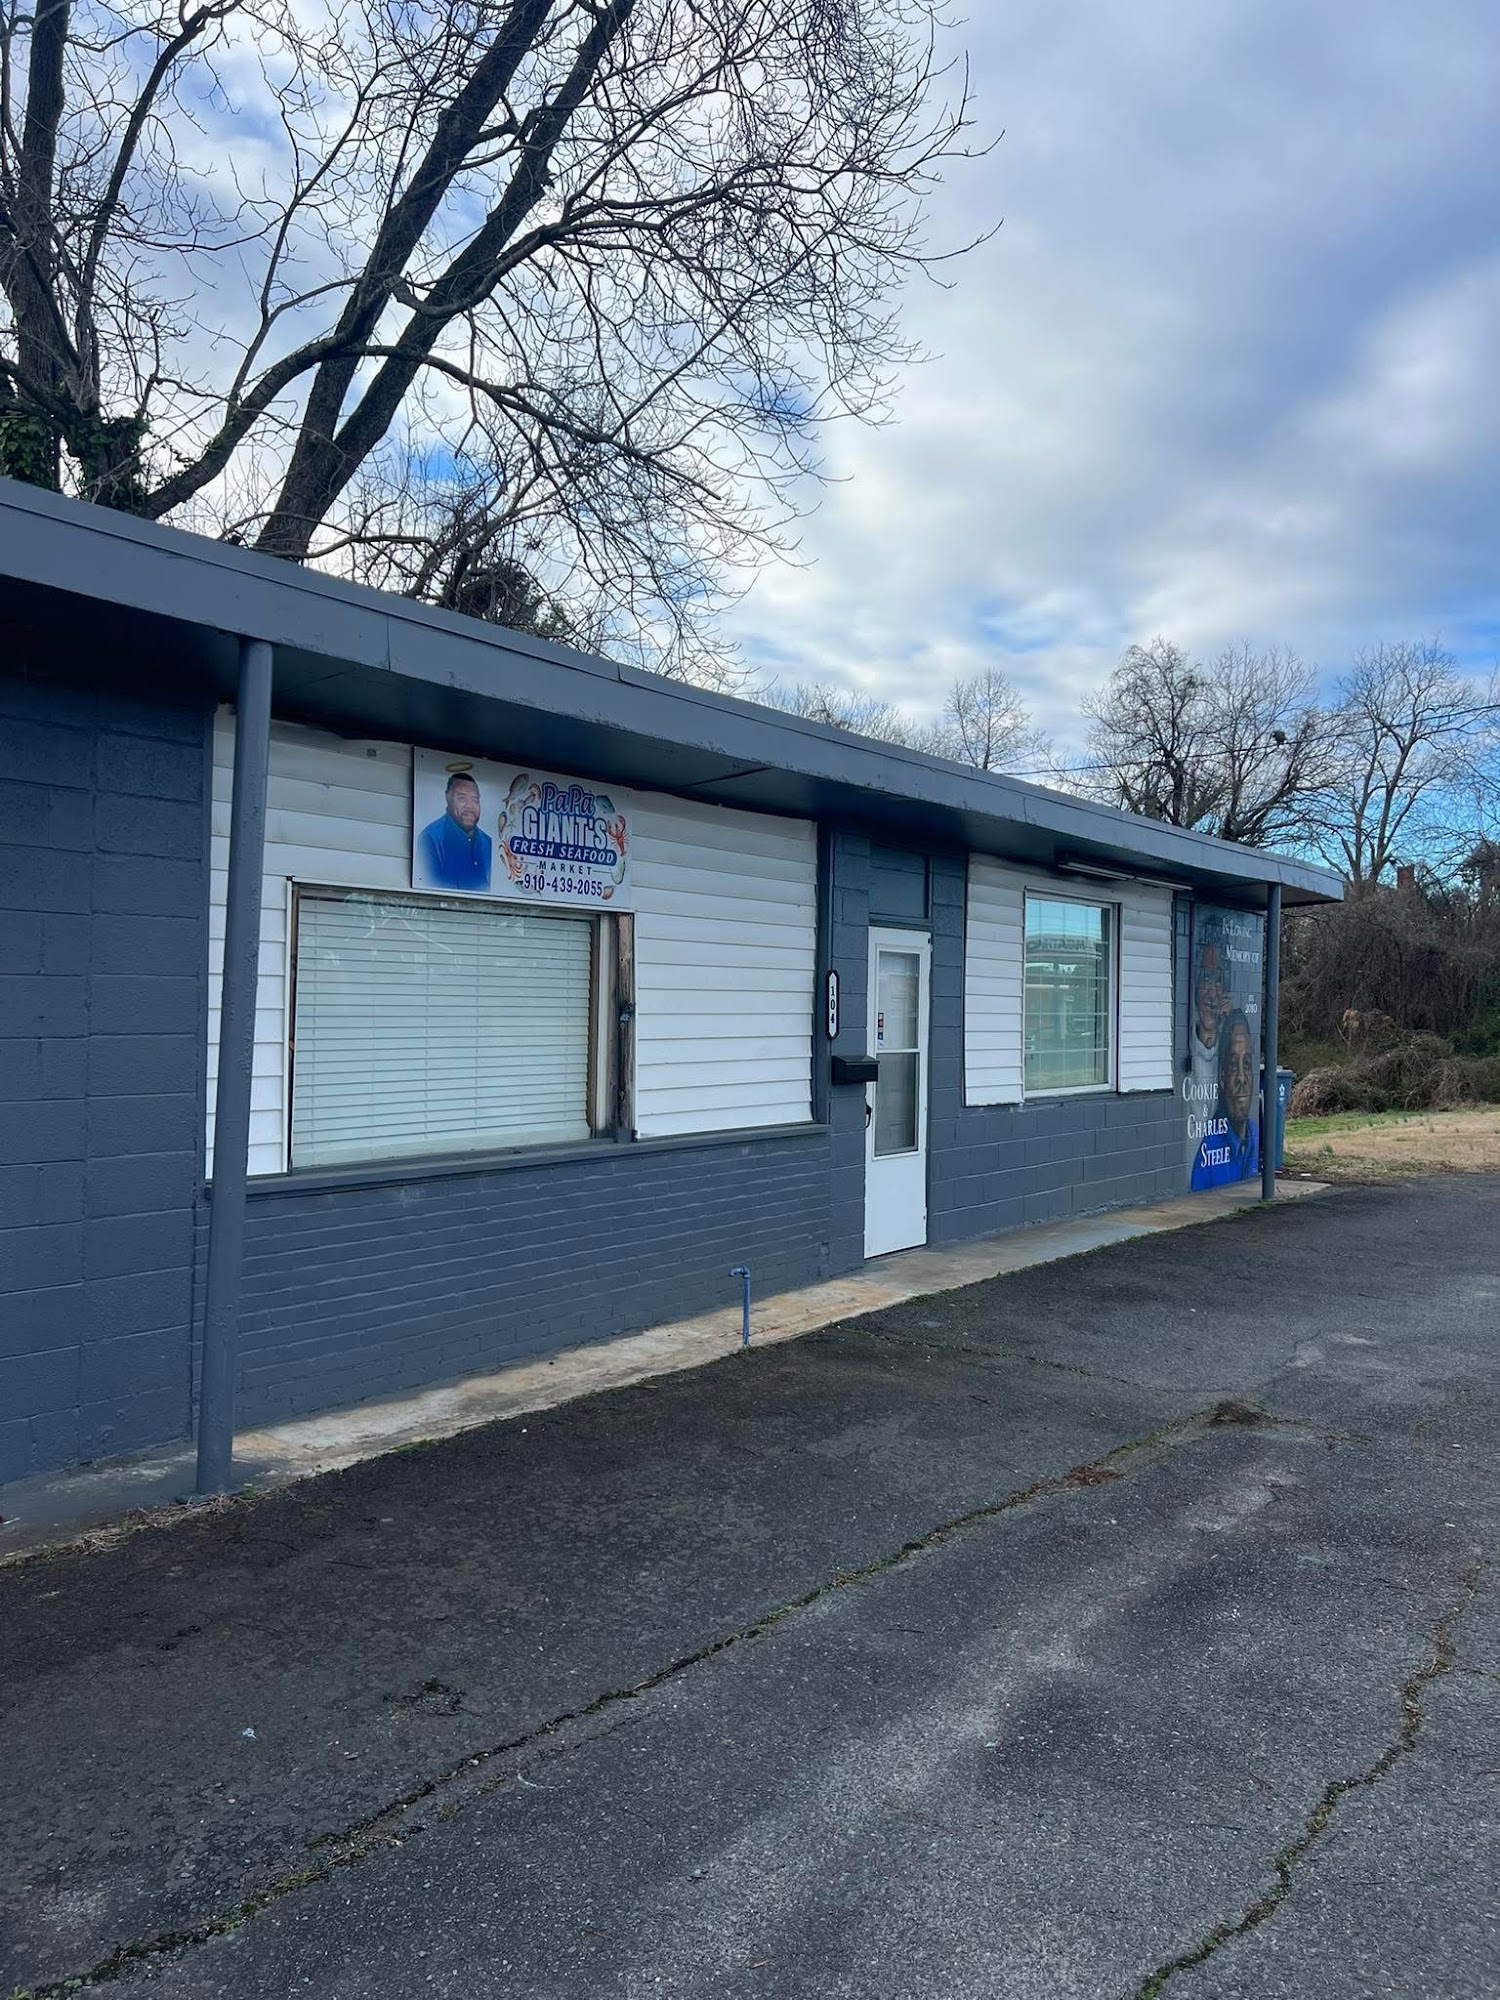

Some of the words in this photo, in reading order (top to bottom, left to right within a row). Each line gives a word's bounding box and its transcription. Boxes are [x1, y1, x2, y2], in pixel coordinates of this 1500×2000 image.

[512, 840, 555, 856] FRESH
[559, 845, 615, 864] SEAFOOD
[539, 860, 592, 875] MARKET
[524, 873, 603, 897] 910-439-2055
[1202, 1104, 1209, 1117] &
